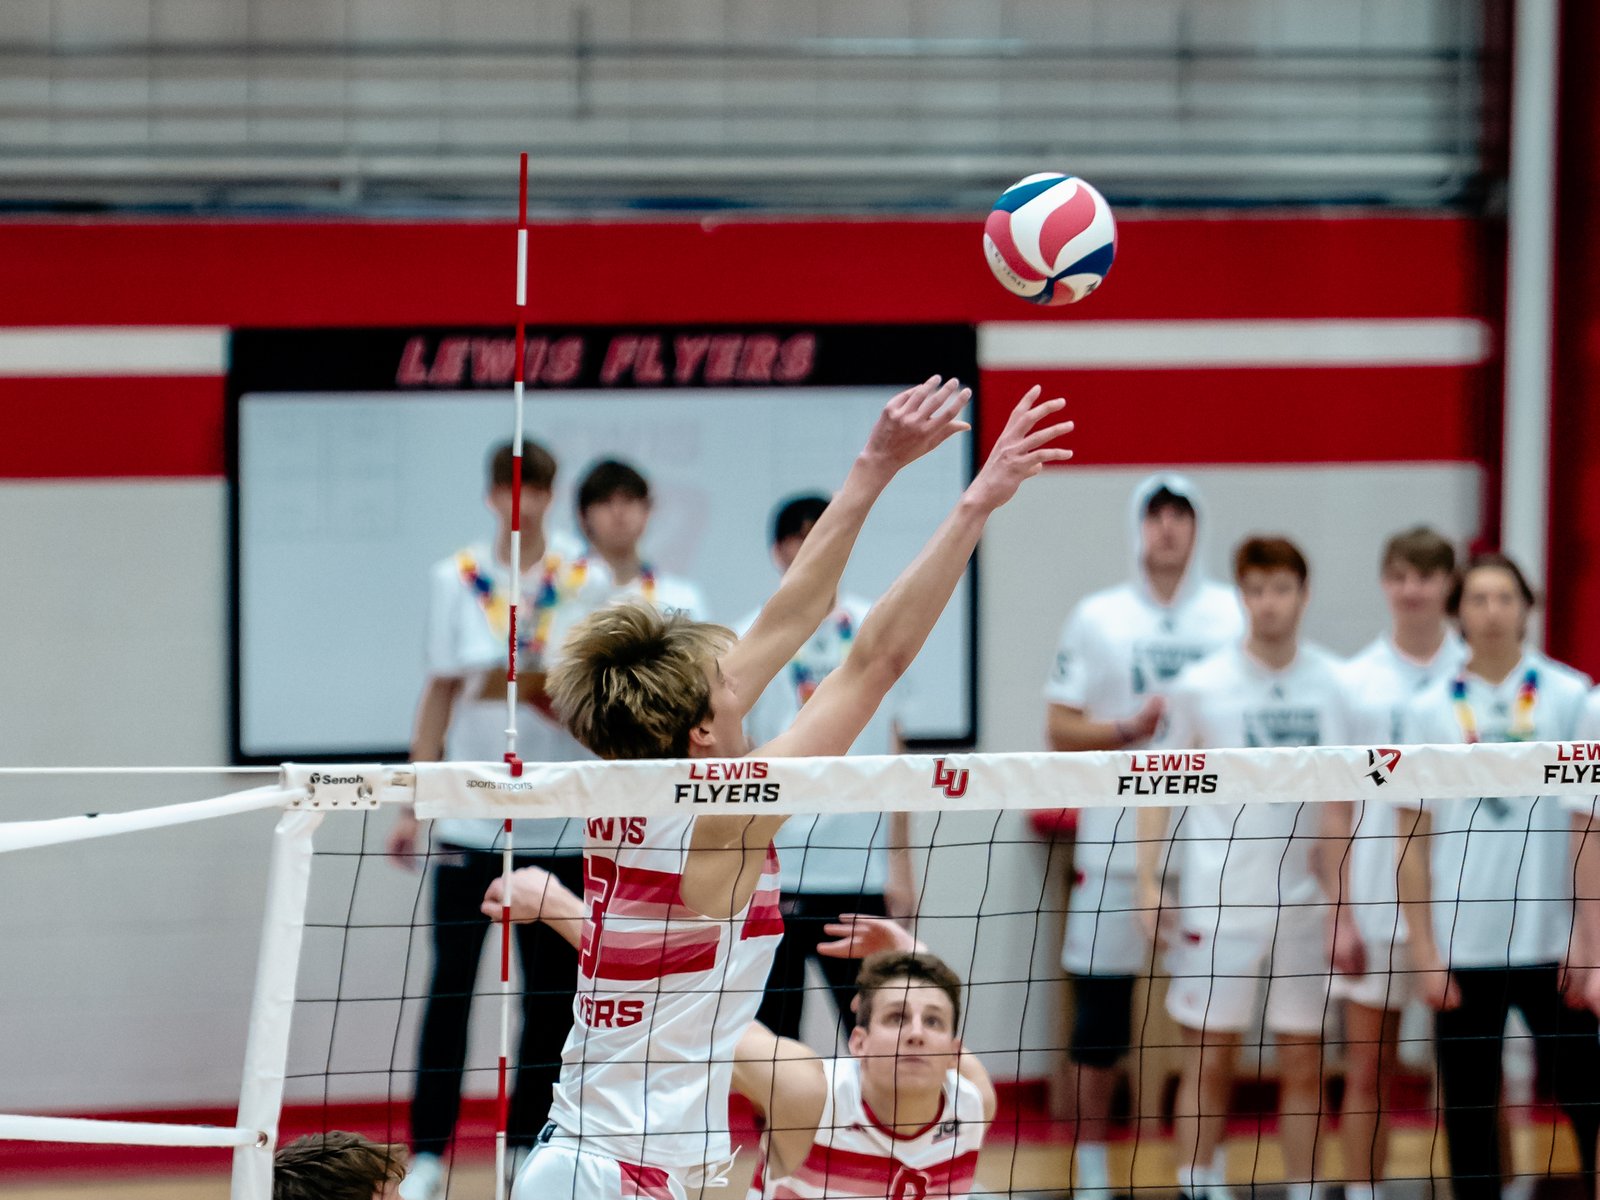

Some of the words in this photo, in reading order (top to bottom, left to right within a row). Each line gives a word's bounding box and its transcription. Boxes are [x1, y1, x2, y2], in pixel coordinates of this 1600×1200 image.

[396, 335, 584, 385] LEWIS
[600, 333, 816, 383] FLYERS
[688, 761, 769, 780] LEWIS
[1130, 753, 1206, 772] LEWIS
[322, 774, 364, 785] Senoh
[466, 778, 496, 790] sports
[497, 780, 533, 791] imports
[1117, 774, 1218, 795] FLYERS
[674, 783, 780, 803] FLYERS
